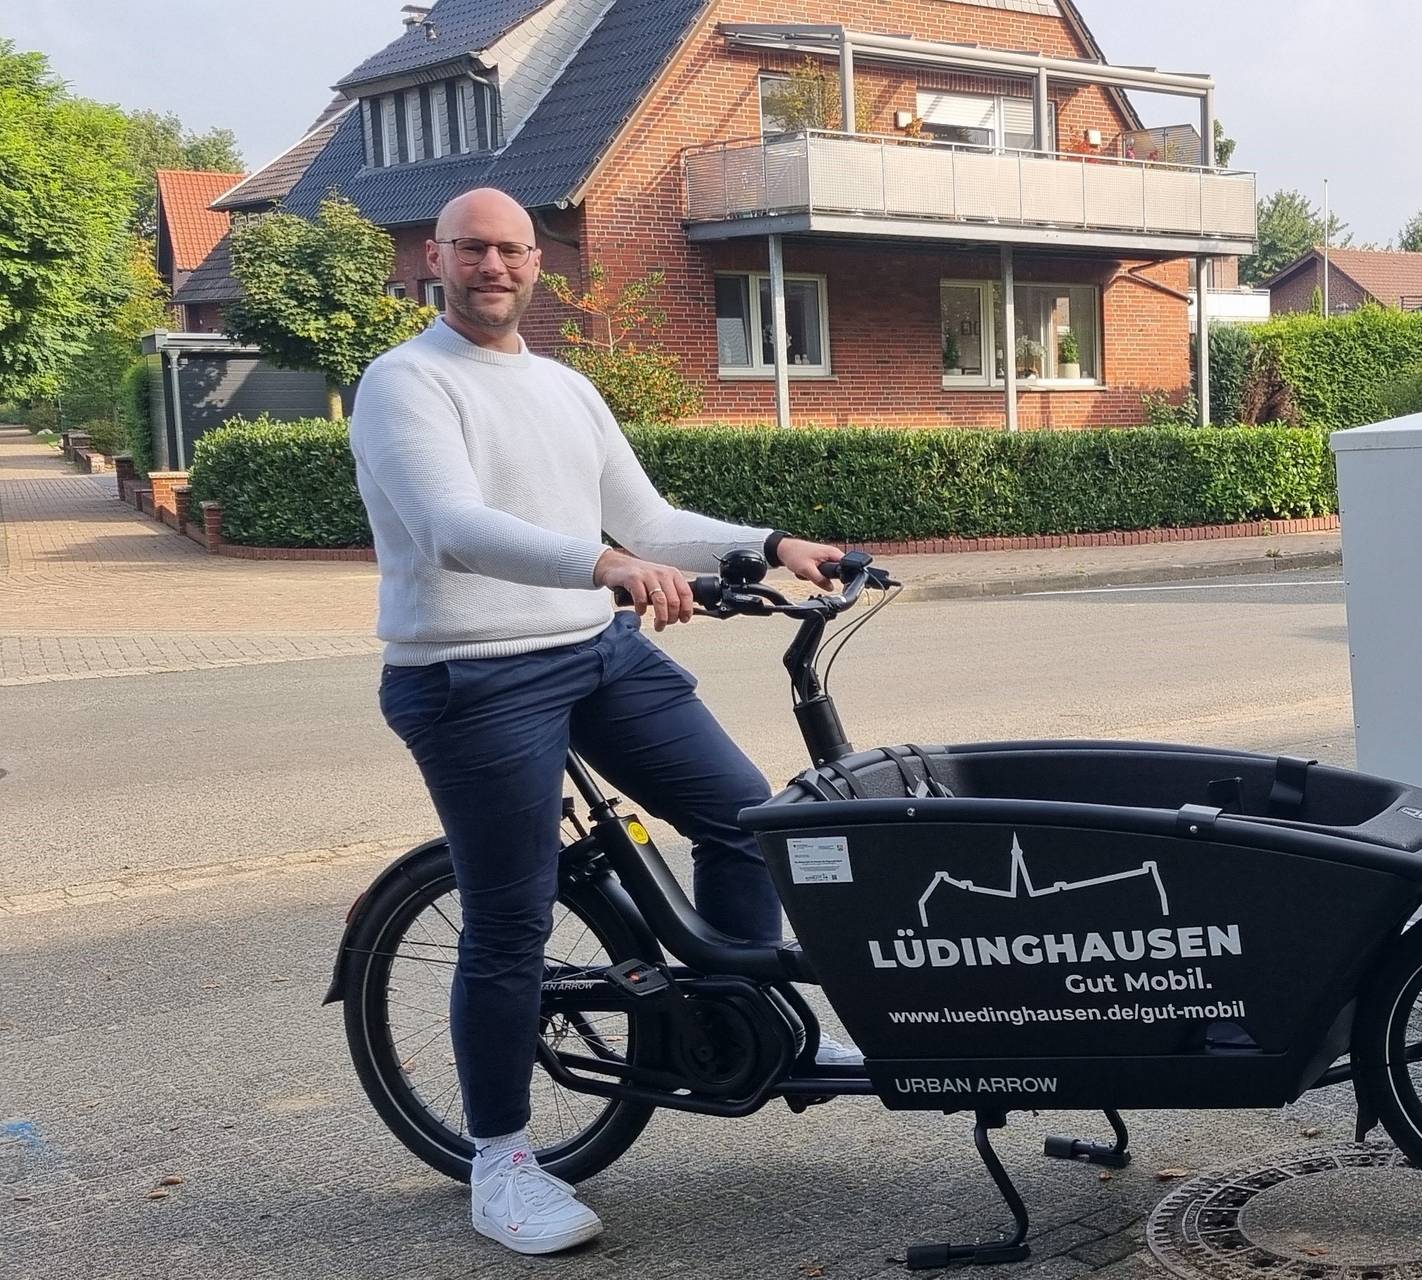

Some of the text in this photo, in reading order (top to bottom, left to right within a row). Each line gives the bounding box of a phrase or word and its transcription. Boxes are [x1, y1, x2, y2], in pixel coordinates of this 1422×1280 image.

[868, 924, 1242, 969] LÜDINGHAUSEN
[558, 982, 594, 991] ARROW
[1065, 967, 1213, 994] Gut Mobil.
[888, 1000, 1246, 1026] www.luedinghausen.de/gut-mobil
[895, 1077, 1057, 1093] URBAN ARROW
